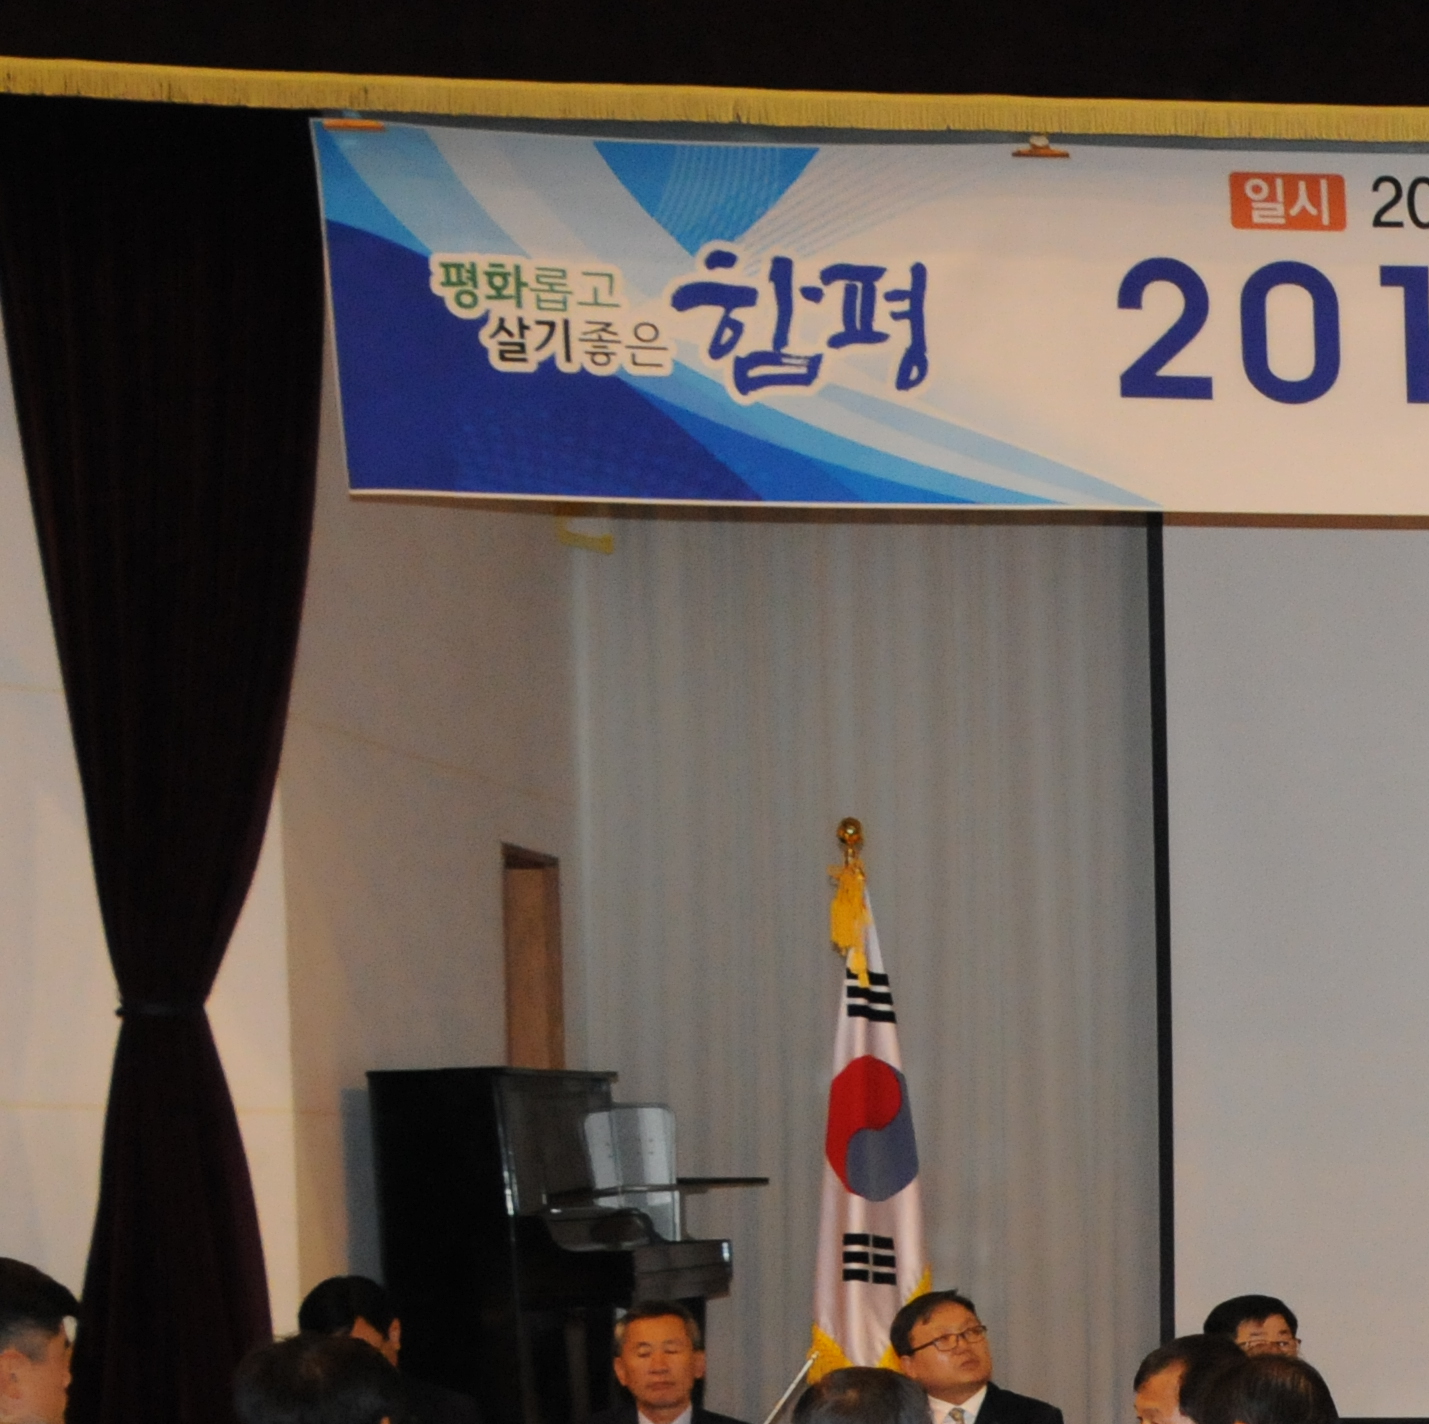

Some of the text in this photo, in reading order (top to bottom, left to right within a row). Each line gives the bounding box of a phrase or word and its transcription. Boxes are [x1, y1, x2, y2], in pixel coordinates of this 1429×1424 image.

[1243, 177, 1331, 227] 일시
[438, 260, 621, 312] 평화롭고
[489, 315, 669, 368] 살기좋은
[670, 249, 928, 393] 함평
